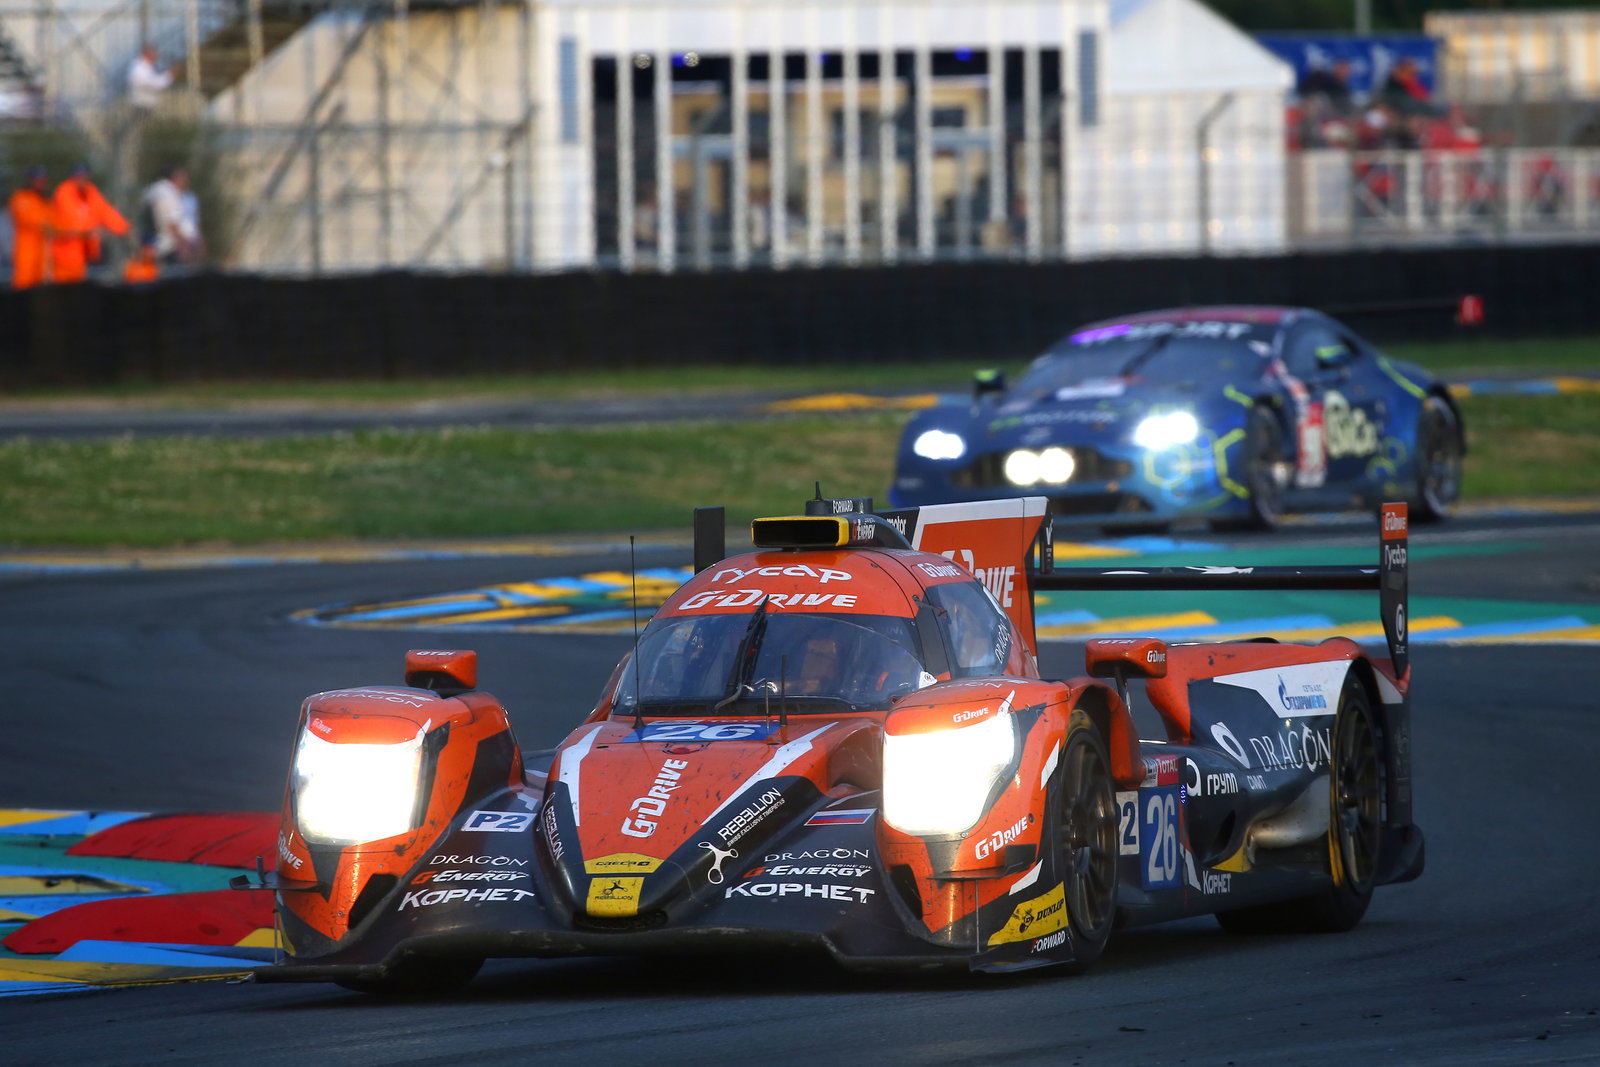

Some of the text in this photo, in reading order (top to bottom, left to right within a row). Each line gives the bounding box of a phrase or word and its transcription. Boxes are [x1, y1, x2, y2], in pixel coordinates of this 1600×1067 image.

[833, 500, 854, 514] FORWARD
[953, 707, 990, 723] G-DRIVE
[641, 723, 762, 741] 26
[1249, 722, 1332, 773] DRAGON
[1157, 758, 1179, 774] TOTAL
[469, 813, 528, 829] P2
[740, 815, 764, 836] EXCLUSIVE
[1146, 793, 1177, 883] 26
[429, 855, 529, 867] DRAGON
[763, 847, 870, 863] DRAGON
[1036, 898, 1065, 921] DUNLOP
[1031, 930, 1066, 954] FORWARD
